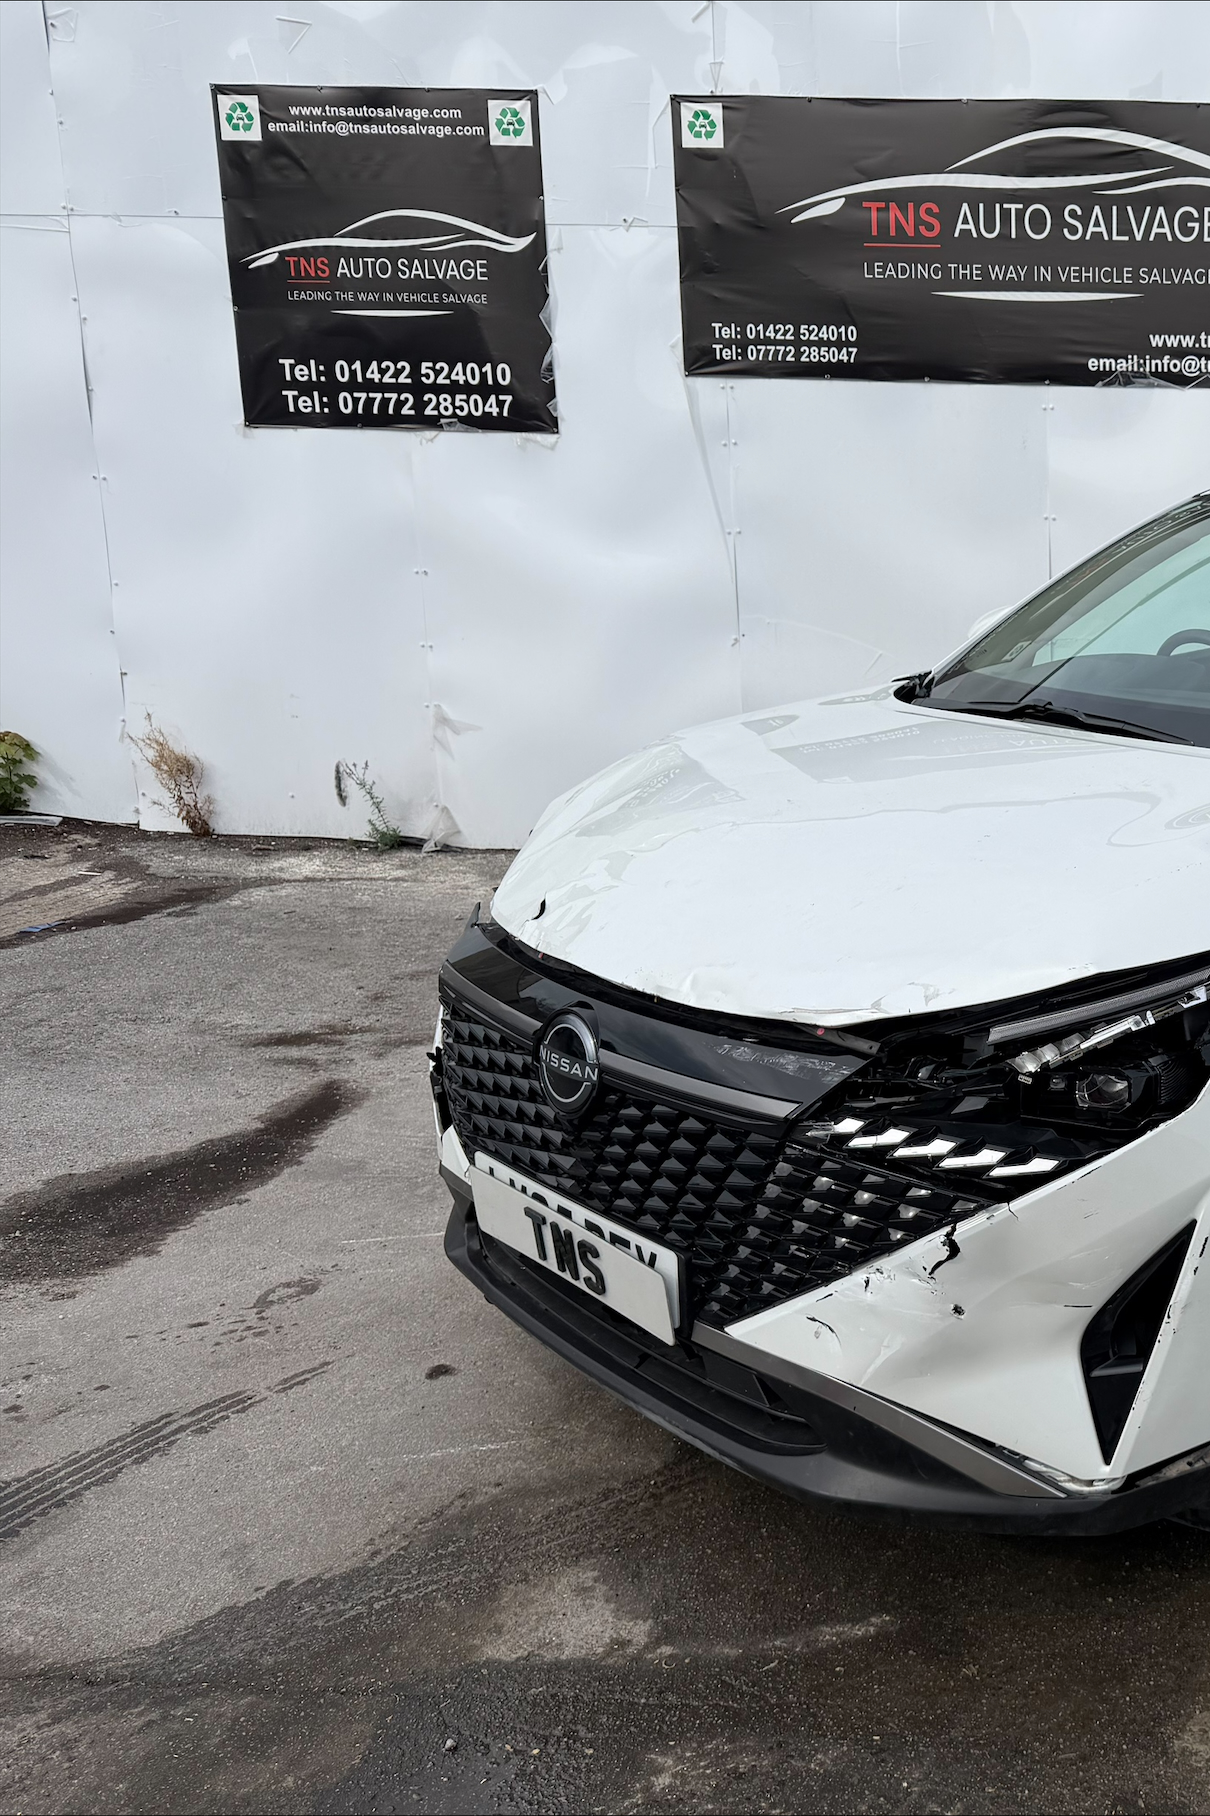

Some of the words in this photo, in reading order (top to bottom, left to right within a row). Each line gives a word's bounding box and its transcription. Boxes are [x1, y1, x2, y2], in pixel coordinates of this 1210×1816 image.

[288, 104, 462, 119] www.tnsautosalvage.com
[268, 120, 485, 137] email:info@tnsautosalvage.com
[862, 202, 941, 237] TNS
[954, 203, 1052, 240] AUTO
[285, 256, 330, 277] TNS
[337, 258, 391, 279] AUTO
[397, 259, 488, 280] SALVAGE
[863, 262, 942, 280] LEADING
[948, 264, 983, 280] THE
[987, 265, 1029, 282] WAY
[1035, 266, 1052, 282] IN
[1058, 266, 1133, 283] VEHICLE
[288, 291, 332, 301] LEADING
[335, 291, 354, 301] THE
[357, 291, 380, 302] WAY
[383, 292, 394, 302] IN
[396, 292, 440, 303] VEHICLE
[442, 293, 487, 304] SALVAGE
[712, 322, 741, 340] Tel:
[746, 323, 795, 341] 01422
[800, 325, 857, 342] 524010
[712, 344, 742, 361] Tel:
[747, 345, 795, 362] 07772
[800, 346, 857, 363] 285047
[279, 359, 326, 382] Tel:
[335, 361, 412, 383] 01422
[420, 362, 511, 385] 524010
[282, 390, 329, 414] Tel:
[338, 392, 415, 415] 07772
[423, 394, 513, 417] 285047
[539, 1044, 598, 1081] NISSAN
[524, 1206, 606, 1296] TNS
